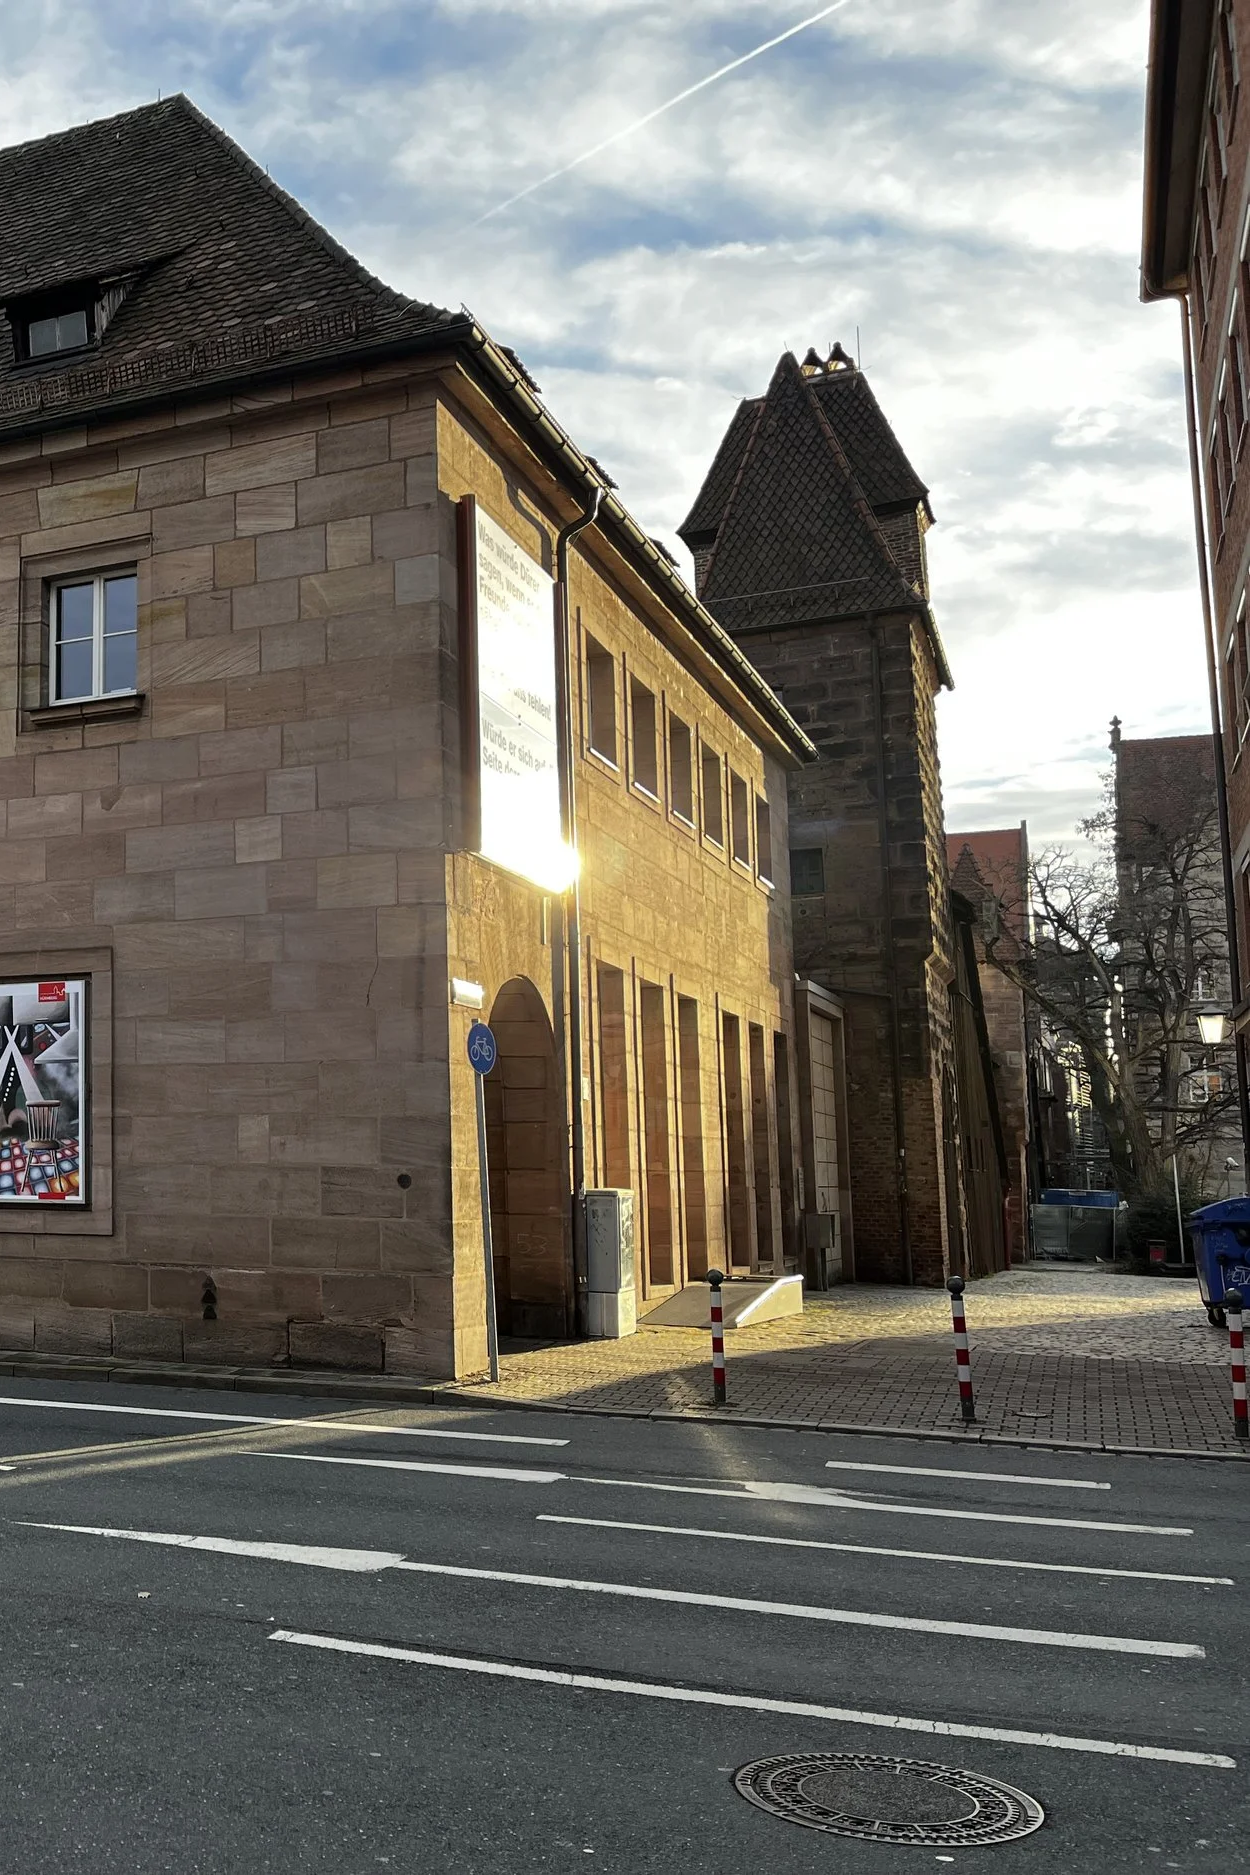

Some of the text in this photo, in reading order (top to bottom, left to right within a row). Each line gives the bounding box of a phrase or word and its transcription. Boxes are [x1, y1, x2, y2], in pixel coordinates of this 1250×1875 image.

[477, 520, 540, 593] Was würde Dürer
[478, 552, 504, 591] sagen,
[505, 576, 526, 604] wenn
[481, 717, 507, 751] Würde
[508, 740, 517, 757] er
[518, 745, 534, 768] sich
[482, 744, 503, 774] Seite
